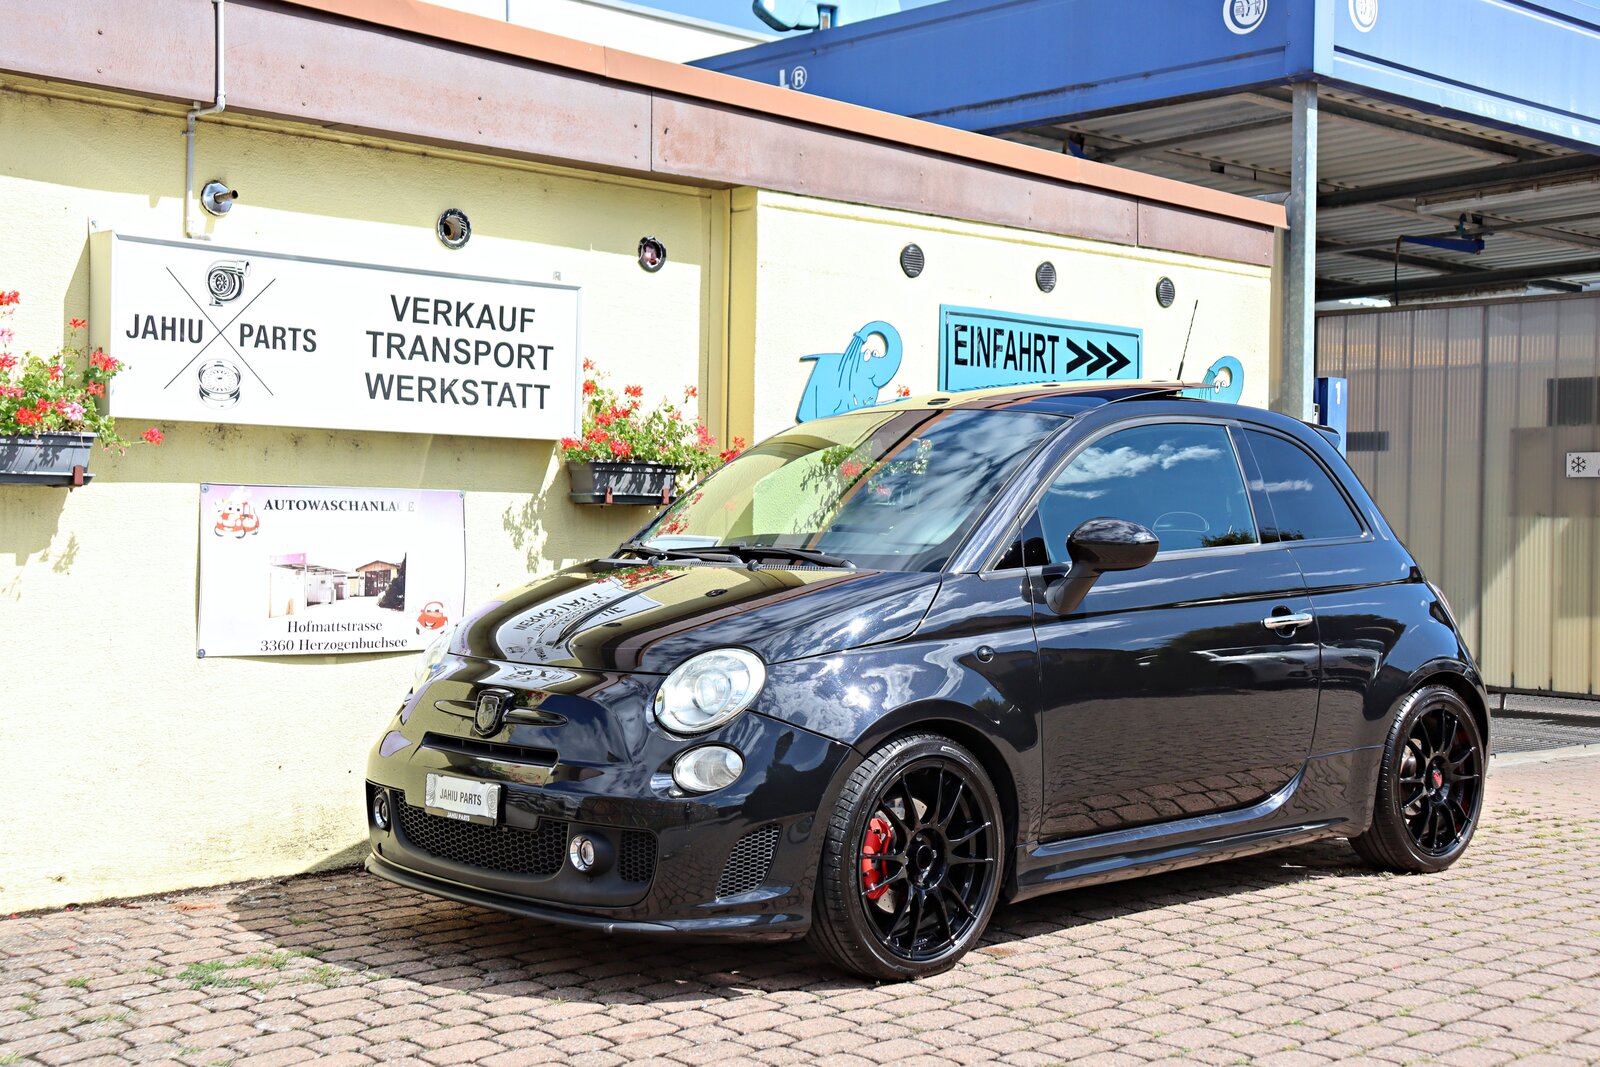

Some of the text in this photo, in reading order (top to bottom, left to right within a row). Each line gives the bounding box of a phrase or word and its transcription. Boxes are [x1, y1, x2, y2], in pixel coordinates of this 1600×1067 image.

[126, 313, 318, 353] JAHIU PARTS
[390, 294, 536, 334] VERKAUF
[365, 331, 555, 371] TRANSPORT
[954, 324, 1059, 374] EINFAHRT
[365, 372, 552, 410] WERKSTATT
[1335, 381, 1341, 405] 1
[260, 636, 408, 652] 3360 Herzogenbuchsee
[287, 620, 383, 633] Hofmattstrasse
[439, 788, 482, 806] JAHIU PARTS
